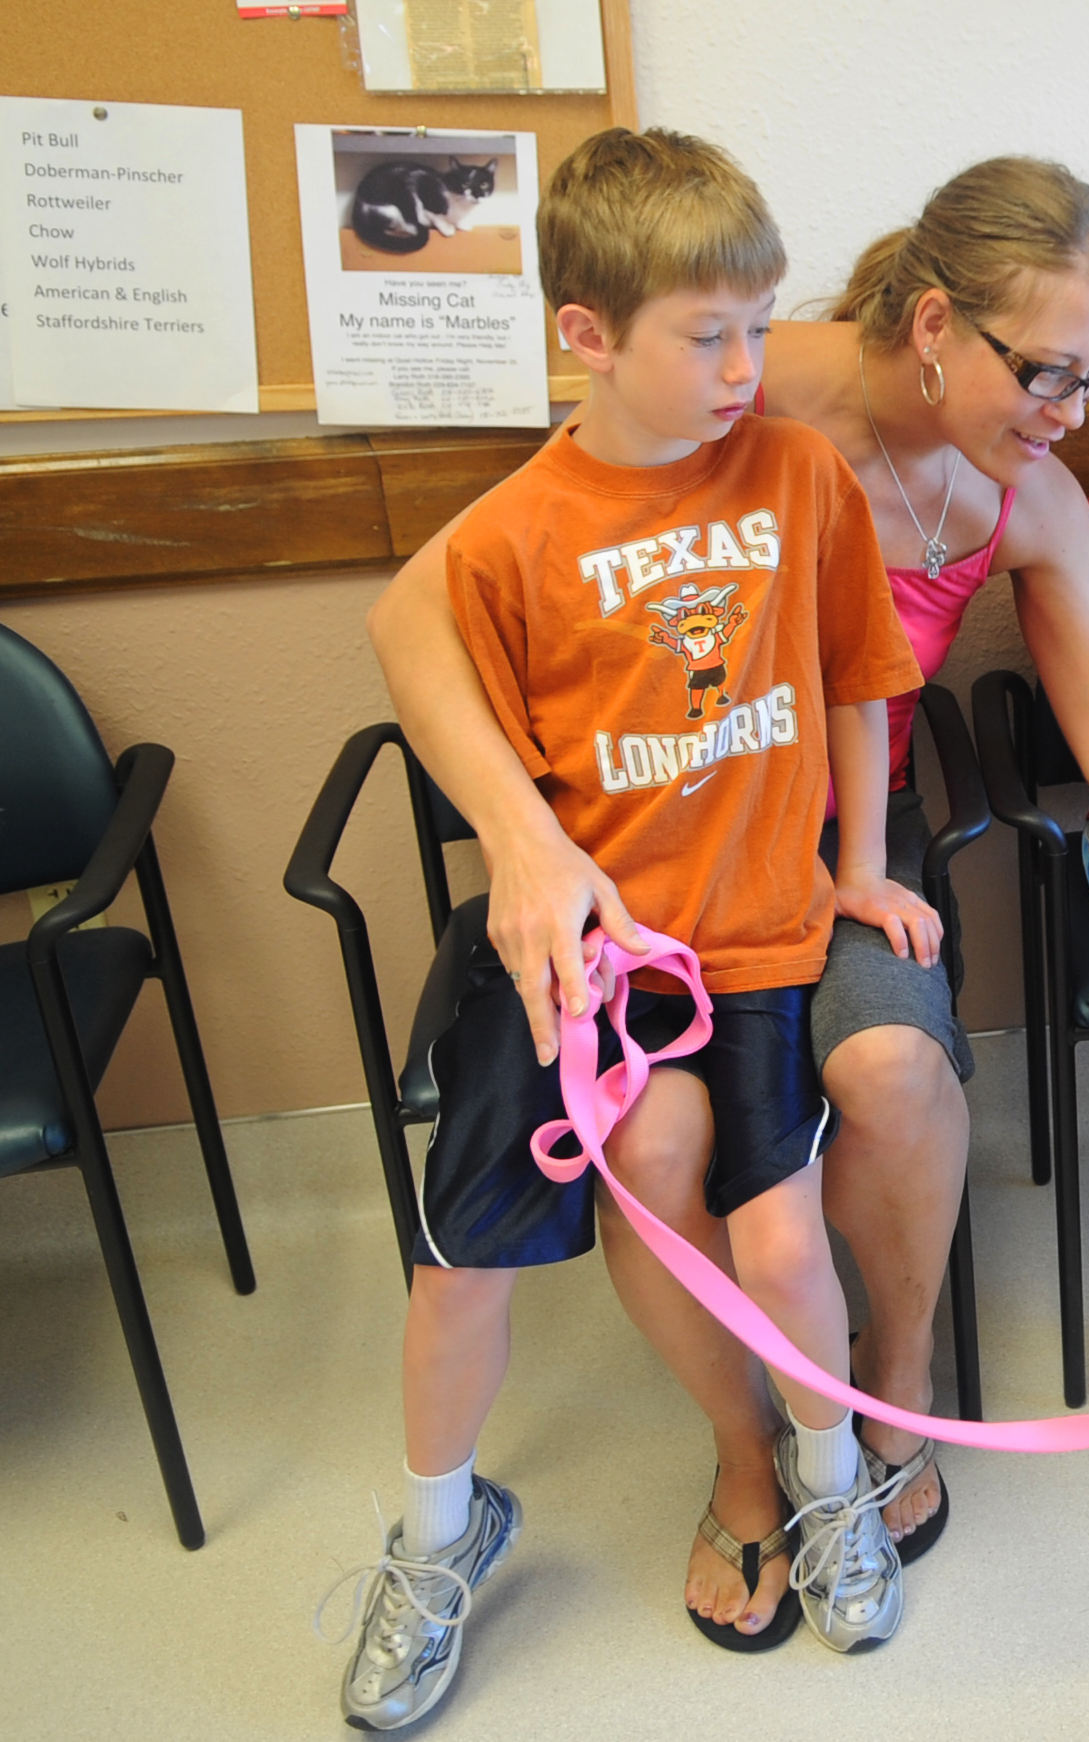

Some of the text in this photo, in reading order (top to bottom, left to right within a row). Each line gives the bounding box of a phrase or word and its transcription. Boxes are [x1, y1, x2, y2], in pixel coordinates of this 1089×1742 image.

[22, 131, 79, 148] Pit Bull
[24, 162, 184, 184] Doberman-Pinscher
[26, 193, 112, 211] Rottweiler
[28, 223, 75, 239] Chow
[30, 254, 136, 272] Wolf Hybrids
[33, 284, 188, 305] American & English
[378, 291, 442, 311] Missing
[446, 292, 475, 308] Cat
[36, 313, 205, 334] Staffordshire Terriers
[339, 313, 364, 331] My
[369, 316, 416, 329] name
[420, 314, 434, 329] is
[577, 508, 781, 619] TEXAS
[694, 639, 707, 654] T
